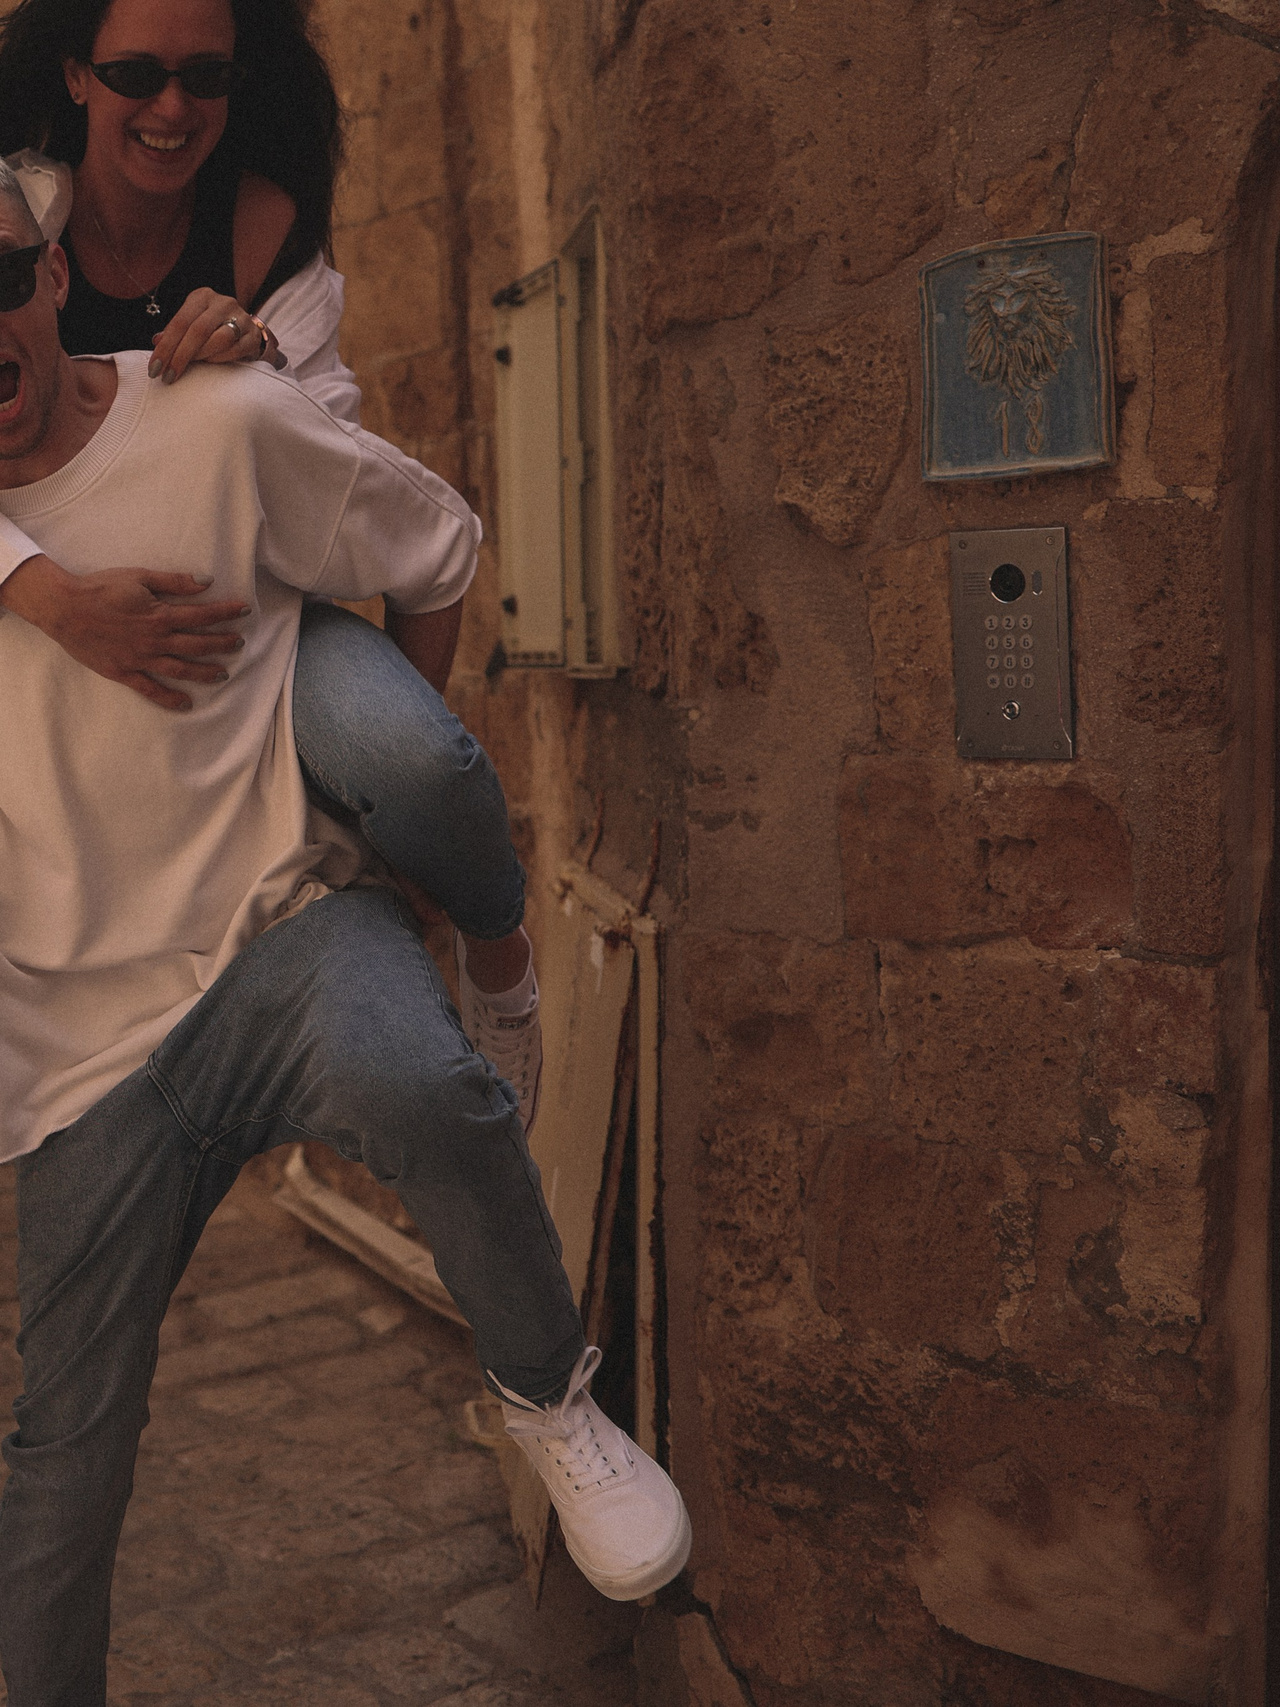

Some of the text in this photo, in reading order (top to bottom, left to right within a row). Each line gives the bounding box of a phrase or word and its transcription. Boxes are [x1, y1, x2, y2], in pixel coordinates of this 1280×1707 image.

[994, 395, 1042, 457] 18
[988, 617, 1029, 628] 1 2 3
[988, 637, 1030, 648] 4 5 6
[989, 656, 1030, 667] 7 8 9
[1007, 677, 1014, 687] 0
